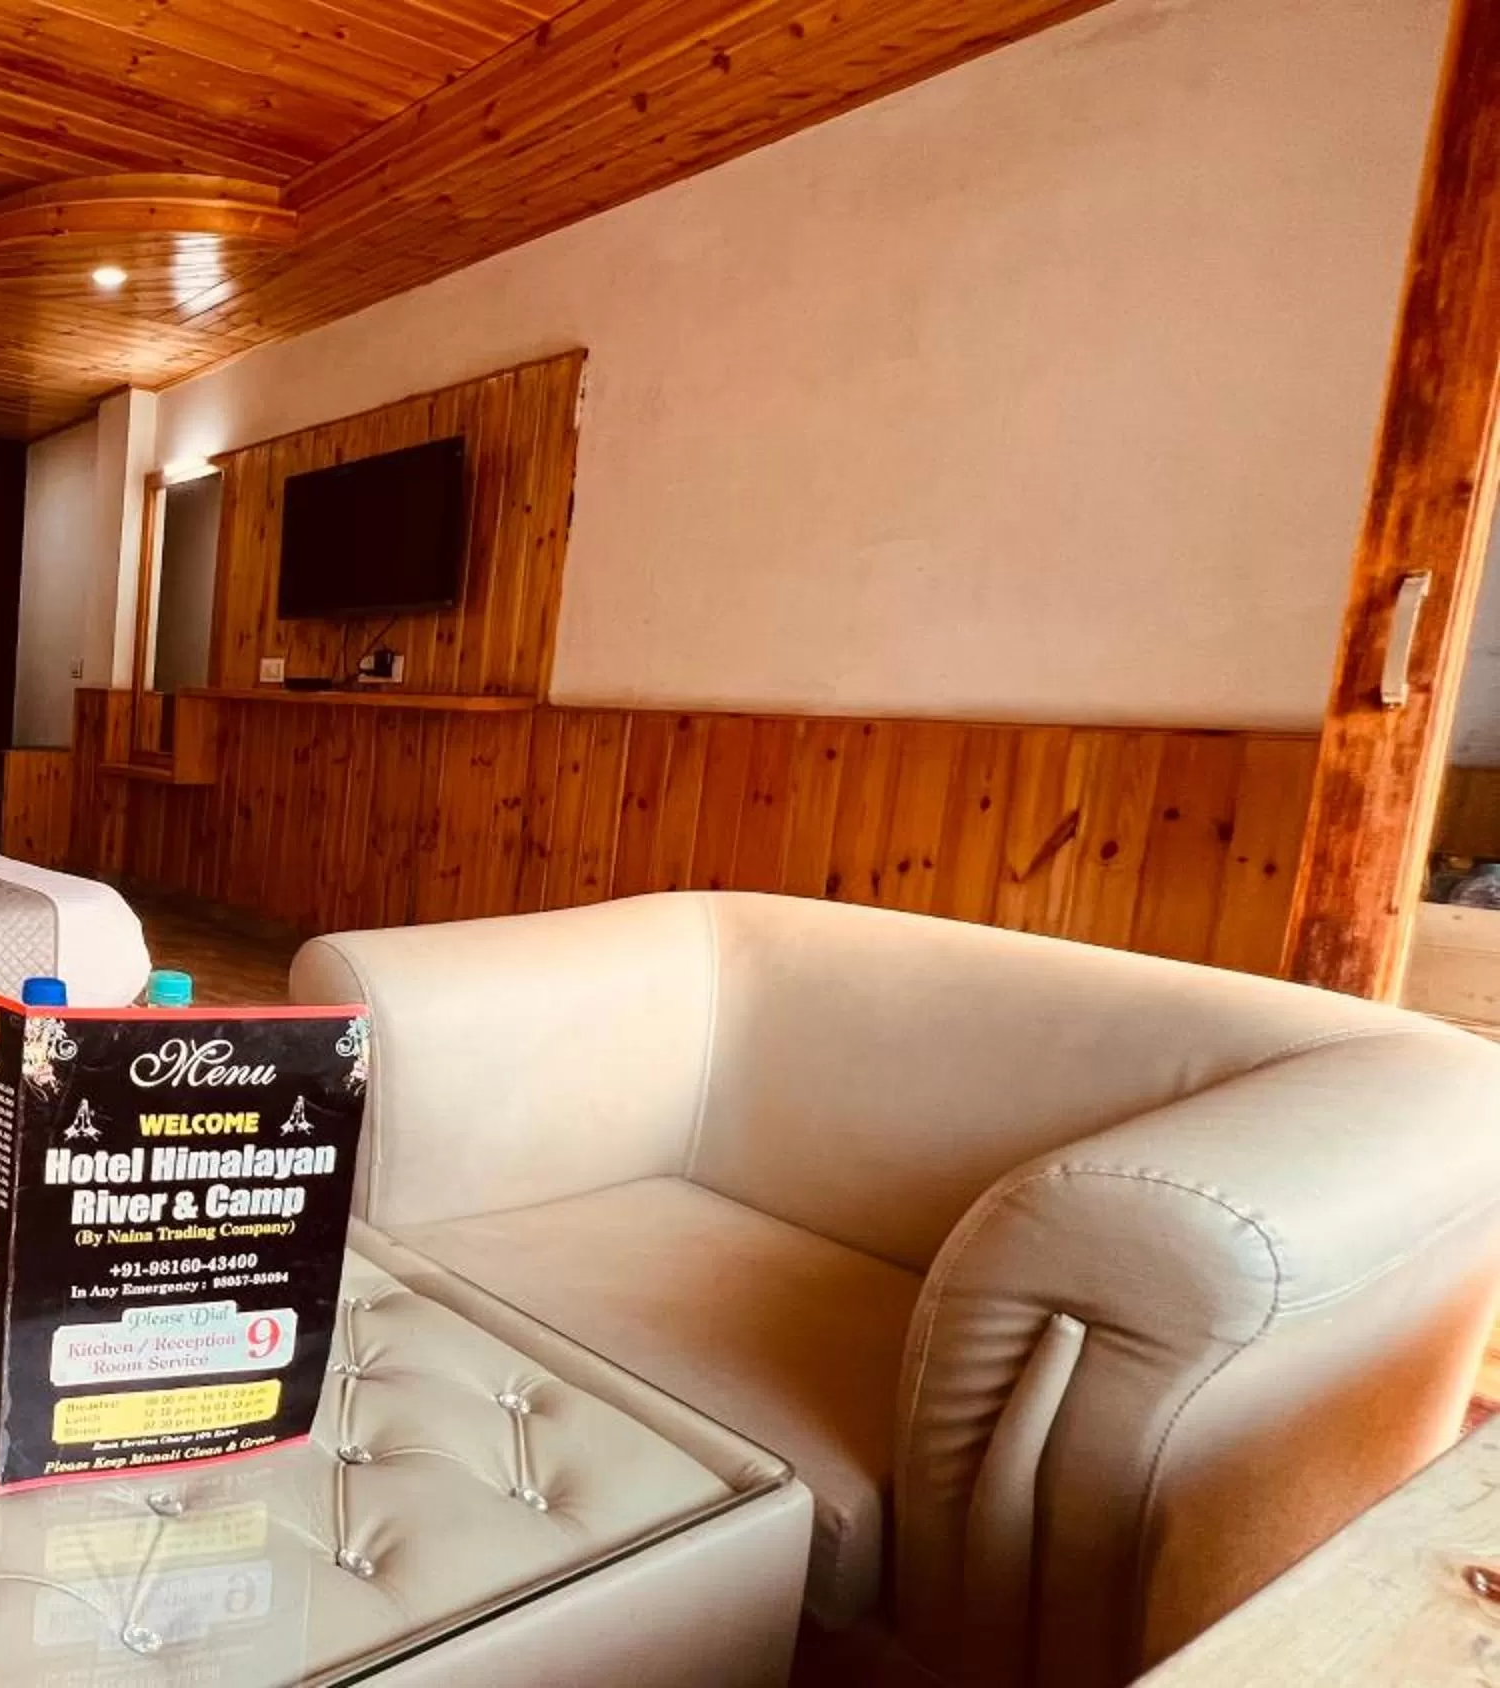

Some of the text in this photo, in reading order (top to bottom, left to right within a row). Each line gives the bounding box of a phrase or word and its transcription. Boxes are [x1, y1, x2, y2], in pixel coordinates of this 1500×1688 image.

[130, 1038, 277, 1087] Menu
[140, 1111, 260, 1137] WELCOME
[44, 1144, 337, 1184] Hotel Himalayan
[71, 1184, 306, 1225] River & Camp
[75, 1220, 296, 1247] (By Naina Trading Company)
[109, 1253, 259, 1278] +91-98160-43400
[71, 1285, 87, 1299] In
[89, 1285, 118, 1299] Any
[127, 1304, 230, 1331] Please Dial
[67, 1340, 134, 1359] Kitchen
[155, 1331, 237, 1352] Reception
[247, 1317, 282, 1359] 9
[91, 1354, 210, 1375] Room Service
[44, 1460, 89, 1474] Please
[92, 1456, 127, 1470] Keep
[129, 1450, 181, 1466] Manali
[183, 1444, 223, 1459] Clean
[239, 1434, 277, 1450] Green
